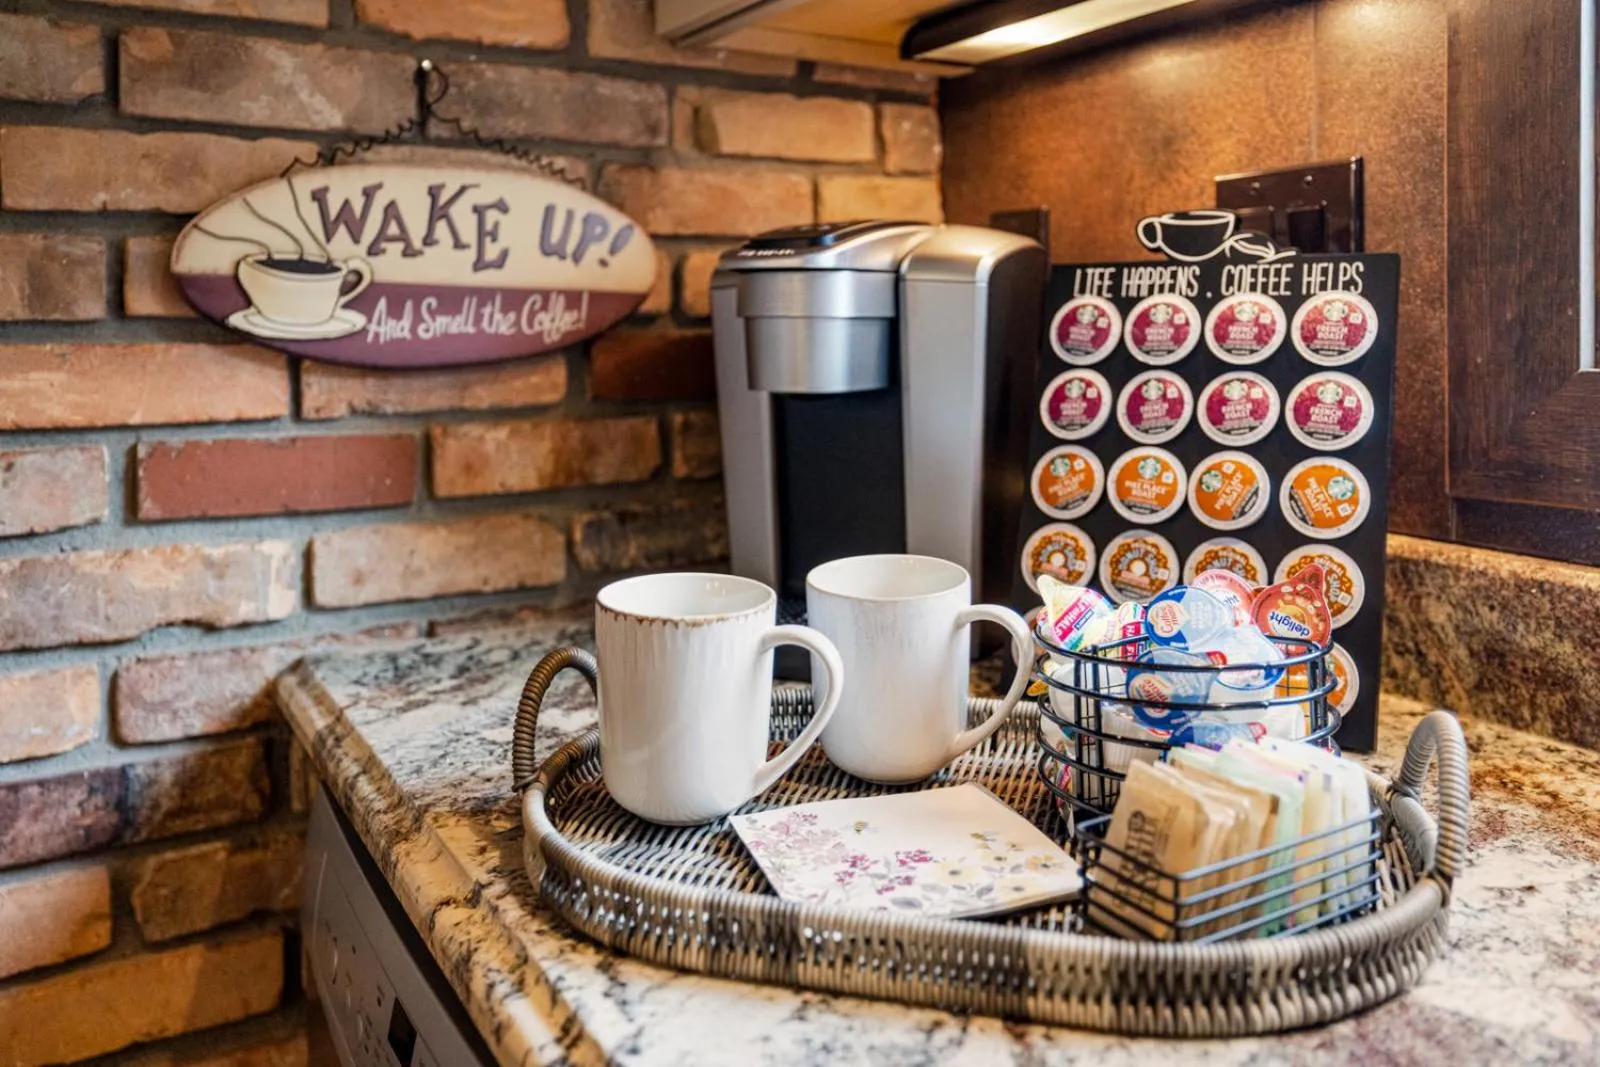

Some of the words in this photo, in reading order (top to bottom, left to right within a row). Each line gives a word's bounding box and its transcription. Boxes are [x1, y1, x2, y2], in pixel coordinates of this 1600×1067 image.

[311, 182, 509, 272] WAKE
[538, 203, 635, 268] UP!
[1073, 267, 1117, 298] LIFE
[1121, 263, 1200, 297] HAPPENS
[1221, 263, 1294, 297] COFFEE
[1302, 261, 1364, 294] HELPS
[366, 296, 412, 344] And
[417, 296, 475, 339] Smell
[481, 295, 518, 334] the
[520, 291, 589, 343] Coffee!
[1269, 611, 1310, 637] delight
